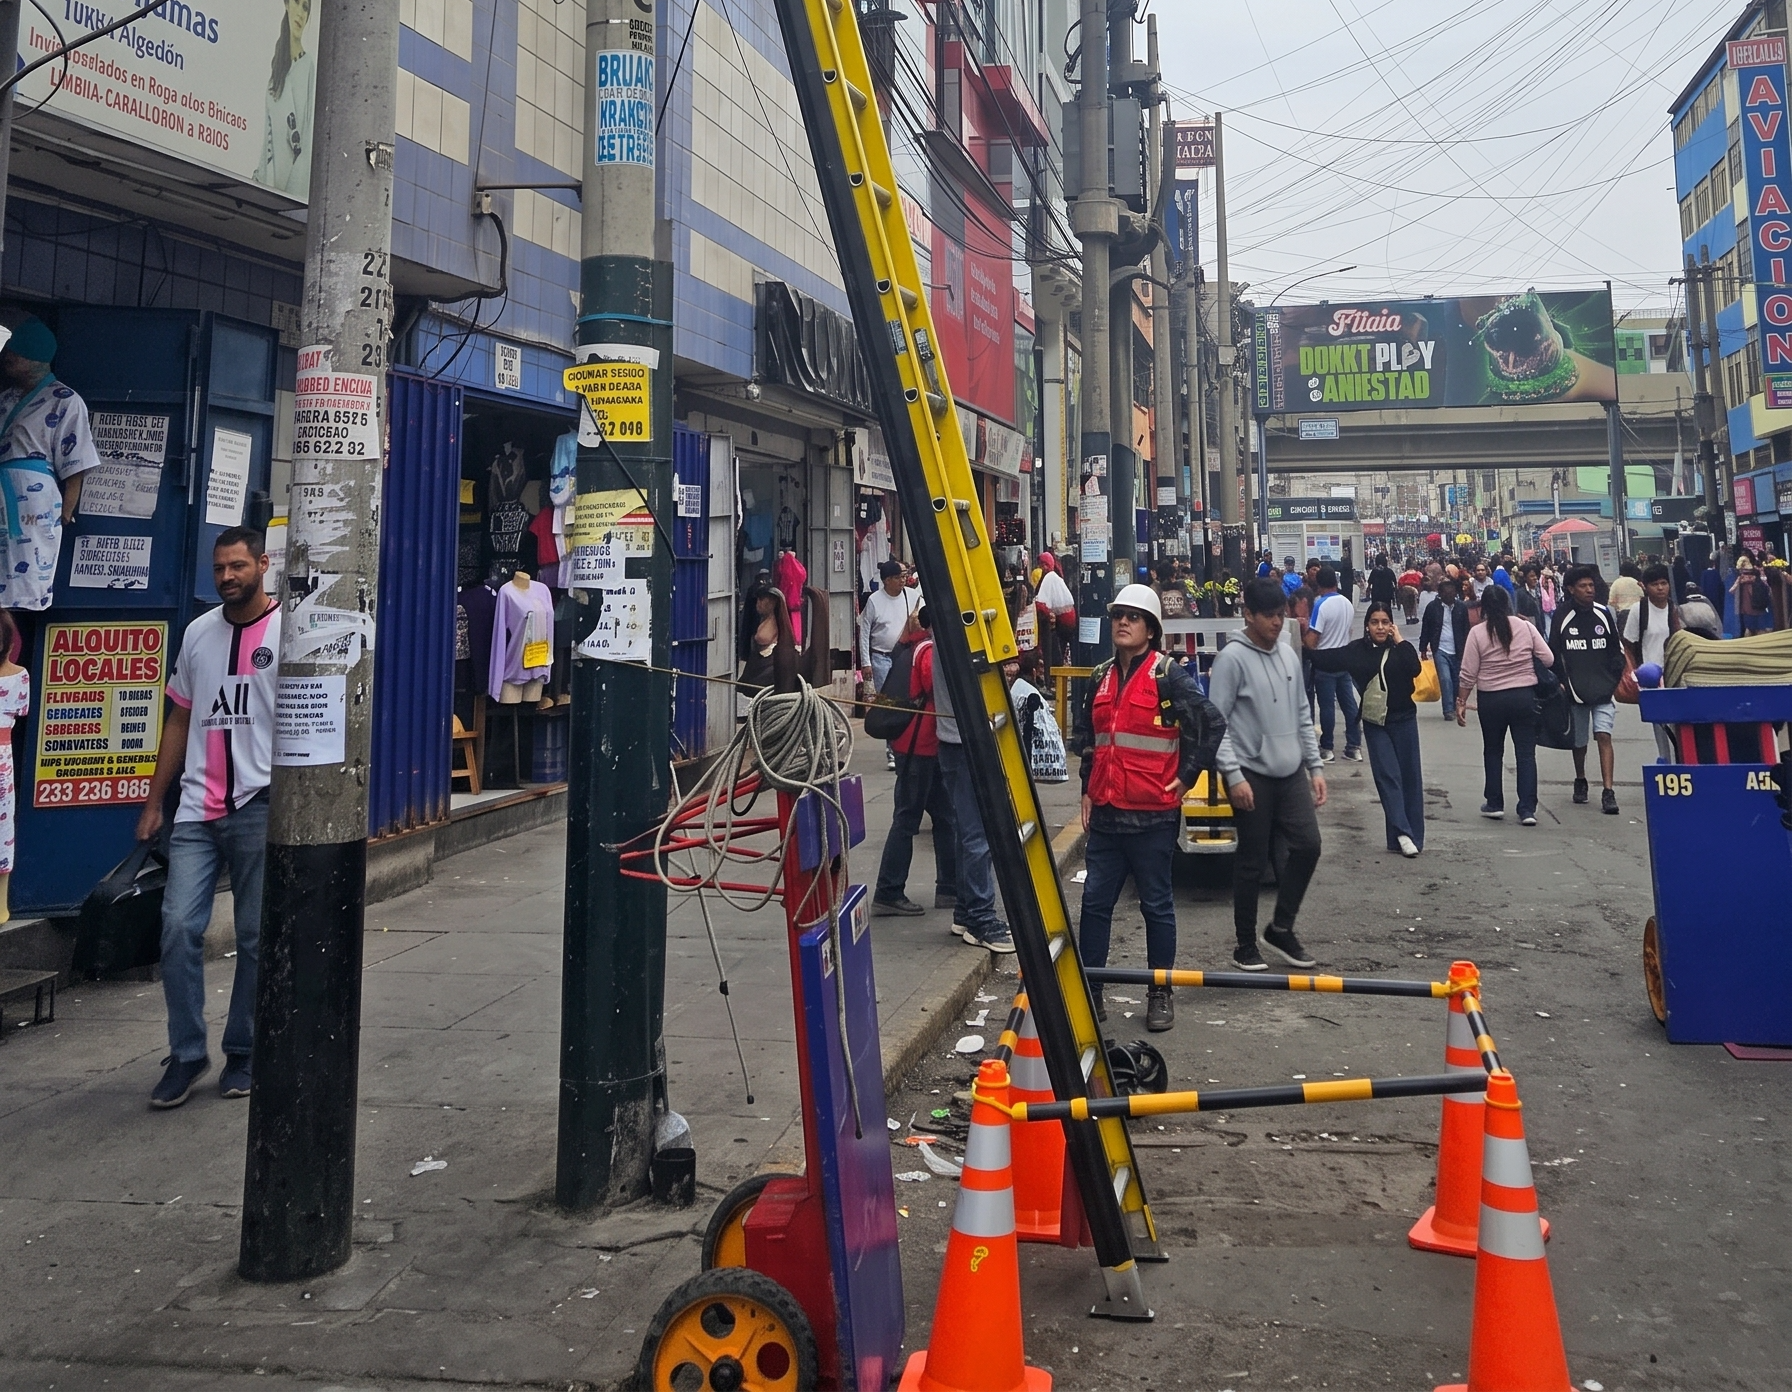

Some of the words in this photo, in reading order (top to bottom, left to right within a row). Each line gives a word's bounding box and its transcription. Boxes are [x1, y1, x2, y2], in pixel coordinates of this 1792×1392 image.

[130, 72, 145, 91] en
[1746, 75, 1792, 364] AVIACION
[49, 656, 160, 684] LOCALES
[38, 782, 73, 803] 233
[79, 781, 112, 801] 236
[1654, 773, 1693, 796] 195
